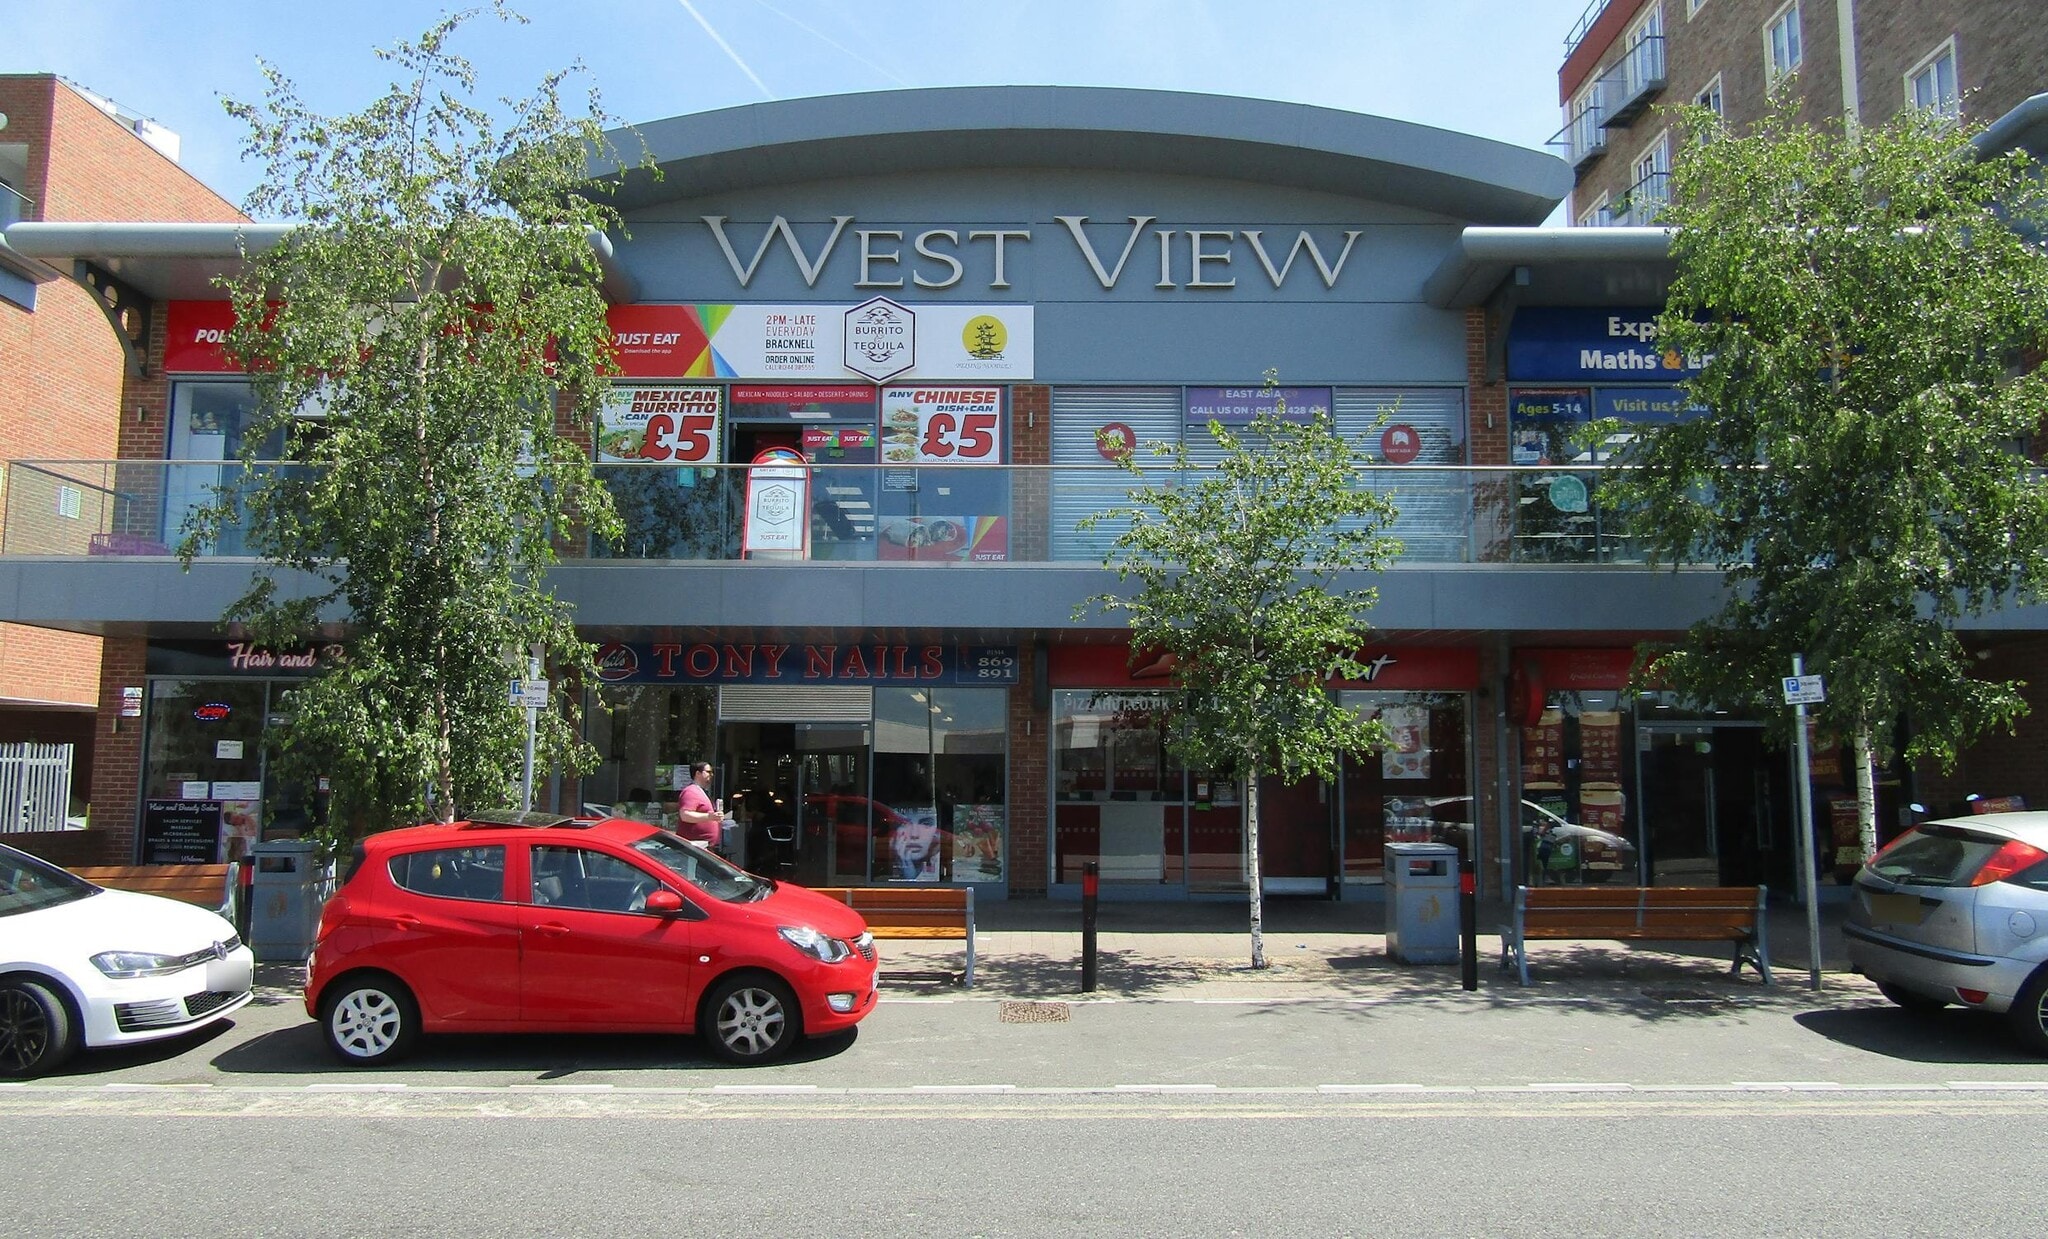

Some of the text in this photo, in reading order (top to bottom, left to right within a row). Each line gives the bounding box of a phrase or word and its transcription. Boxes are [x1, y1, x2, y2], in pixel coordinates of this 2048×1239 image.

[701, 215, 1363, 290] WEST VIEW
[766, 315, 787, 325] 2PM
[794, 315, 816, 325] LATE
[766, 326, 815, 336] EVERYDAY
[855, 326, 904, 335] BURRITO
[615, 333, 681, 346] JUST EAT
[765, 339, 815, 349] BRACKNELL
[853, 341, 905, 350] TEQUILA
[765, 355, 815, 363] ORDER ONLINE
[1580, 349, 1657, 370] Maths
[1662, 349, 1681, 370] &
[633, 390, 717, 402] MEXICAN
[913, 391, 997, 404] CHINESE
[1226, 390, 1254, 398] EAST
[631, 402, 717, 414] BURRITO
[1190, 406, 1215, 414] CALL
[1217, 406, 1230, 414] US
[1233, 406, 1248, 414] ON
[1256, 406, 1285, 414] 0134
[1287, 406, 1306, 414] 428
[1517, 403, 1582, 416] Ages 5-14
[1613, 399, 1648, 412] Visit
[1651, 403, 1667, 412] us
[639, 414, 715, 461] £5
[920, 413, 998, 458] £5
[227, 643, 277, 669] Hair
[279, 648, 318, 668] and
[652, 643, 944, 679] TONY NAILS
[978, 657, 1013, 667] 869
[977, 668, 1013, 679] 891
[198, 706, 229, 718] OPEN
[148, 803, 219, 815] Hair and Beauty Salon
